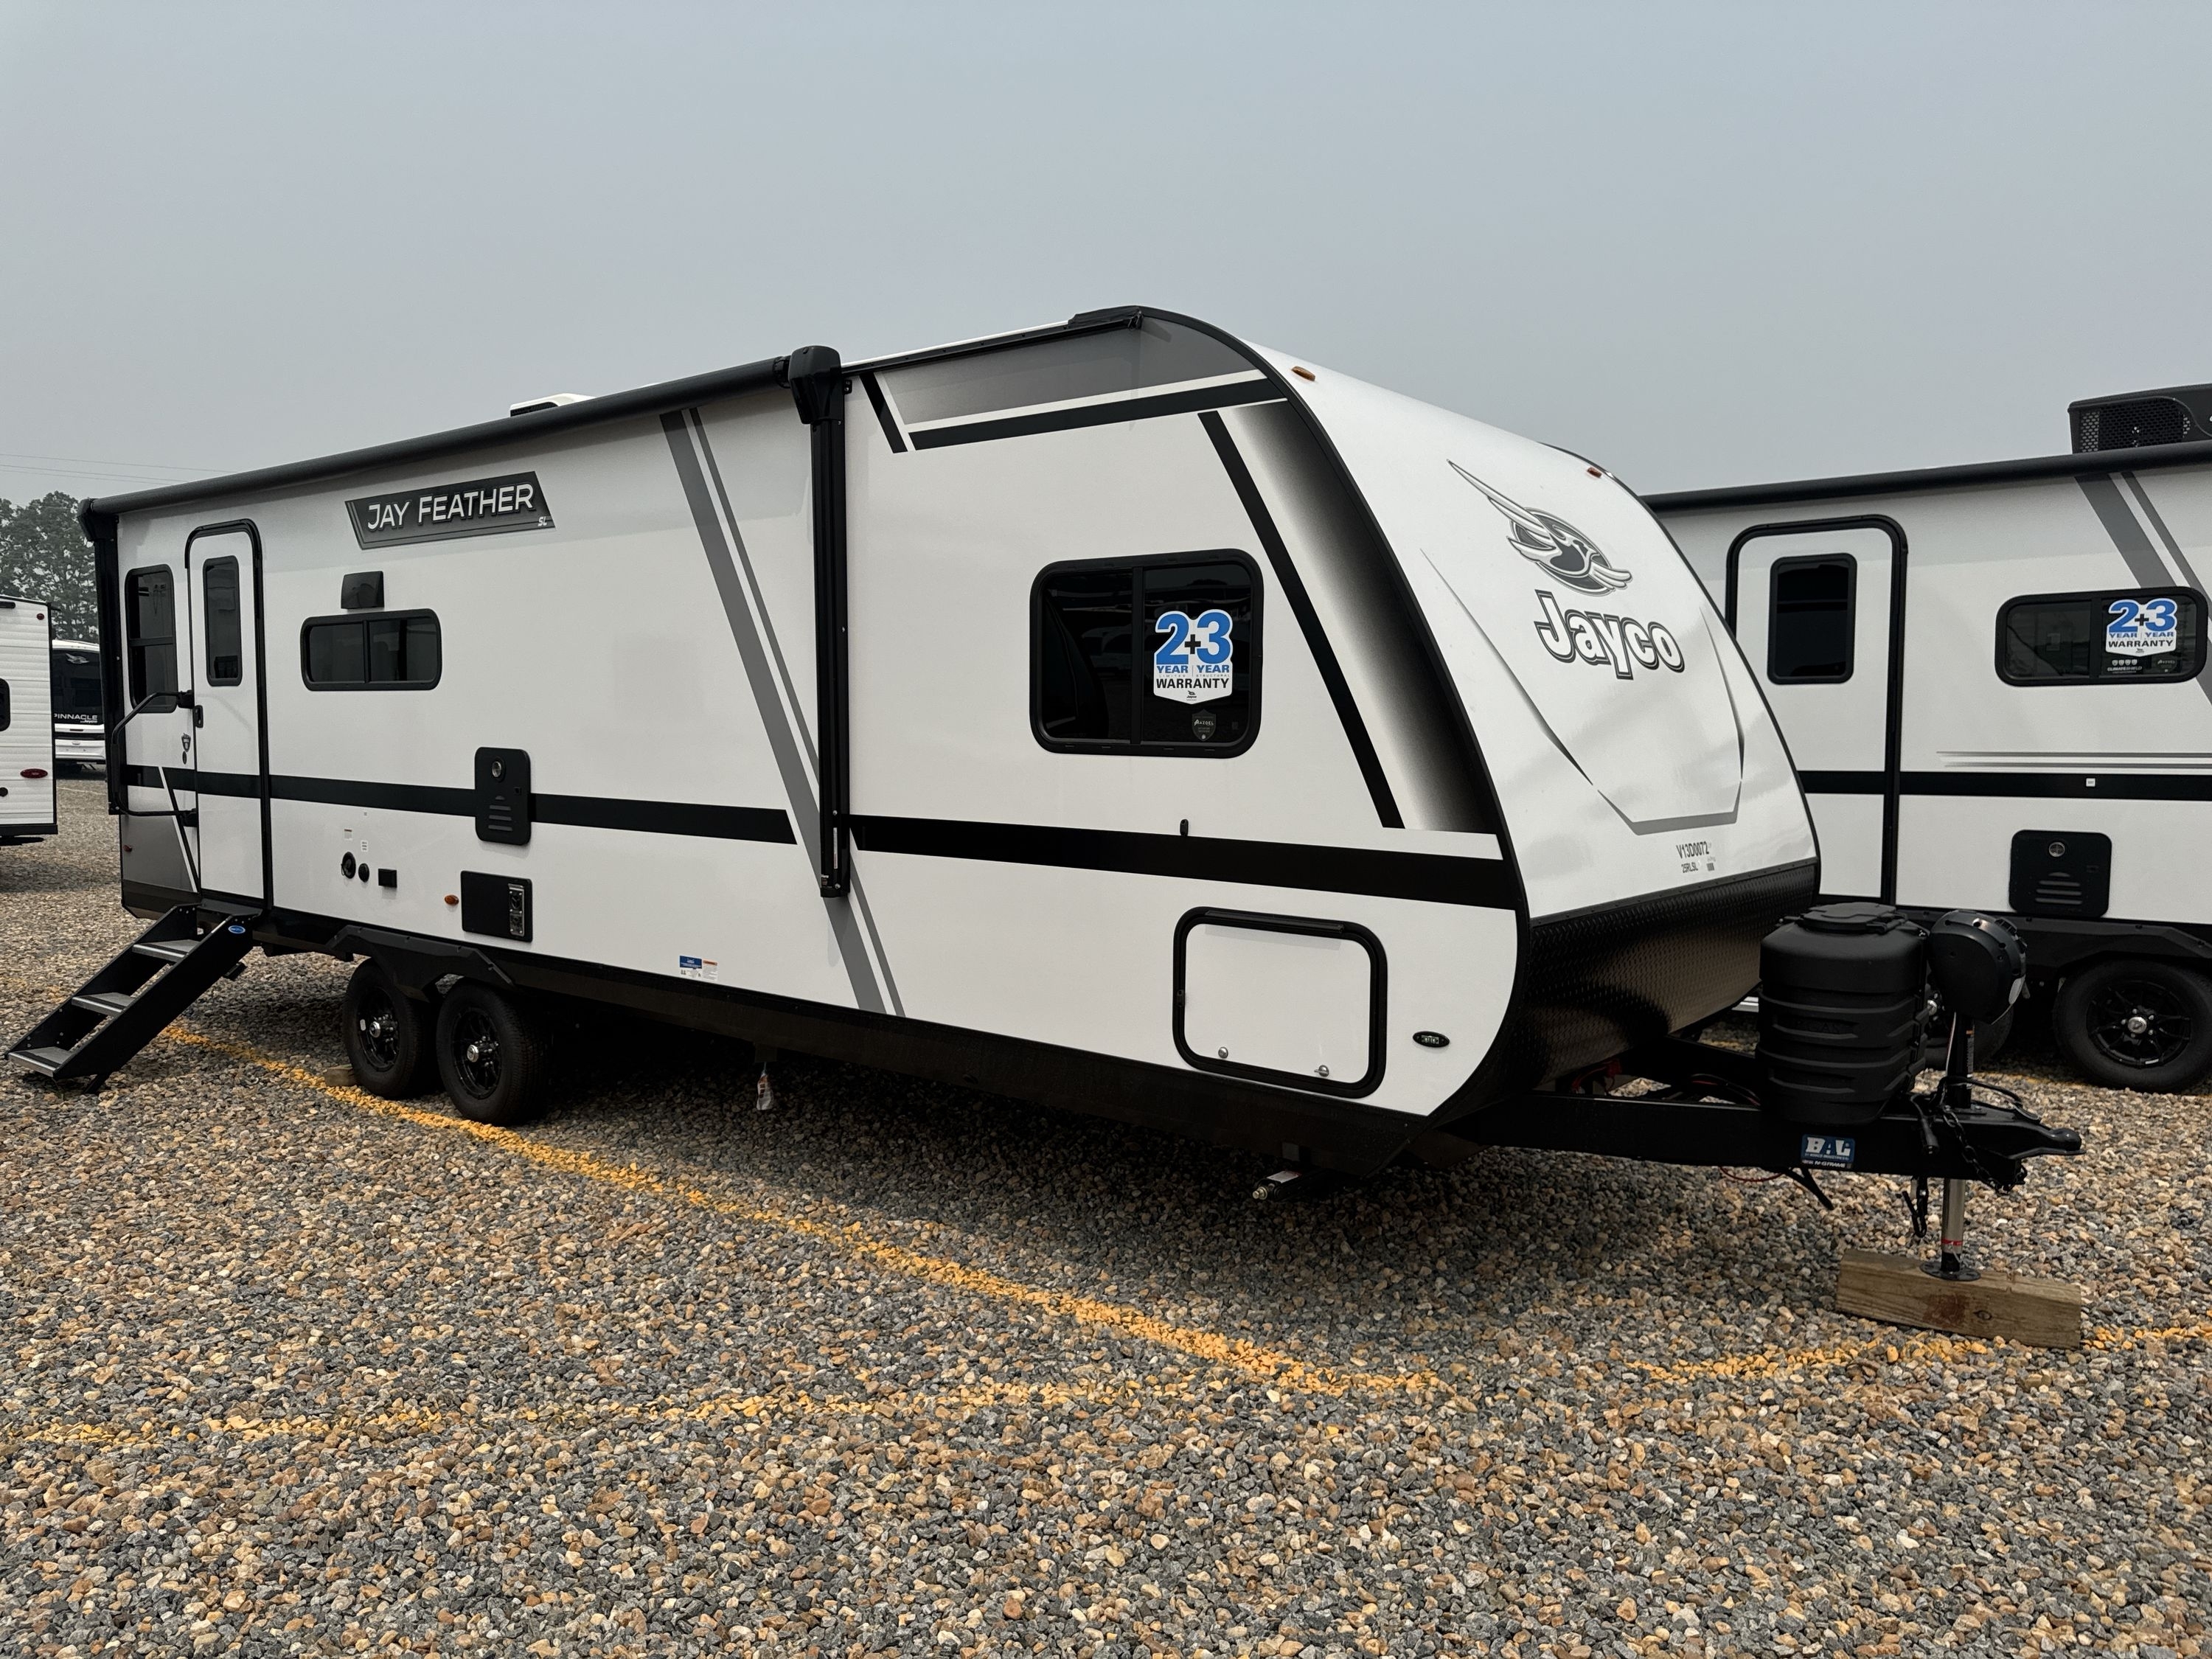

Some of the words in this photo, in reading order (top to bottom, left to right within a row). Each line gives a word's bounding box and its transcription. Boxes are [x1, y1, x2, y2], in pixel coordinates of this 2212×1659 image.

[368, 501, 410, 529] JAY
[418, 484, 533, 523] FEATHER
[538, 516, 547, 526] SL
[1534, 589, 1686, 681] Jayco
[1156, 665, 1189, 673] YEAR
[1197, 664, 1230, 673] YEAR
[1156, 678, 1230, 689] WARRANTY
[1676, 841, 1710, 859] V13D0072
[1805, 1136, 1851, 1157] BAL
